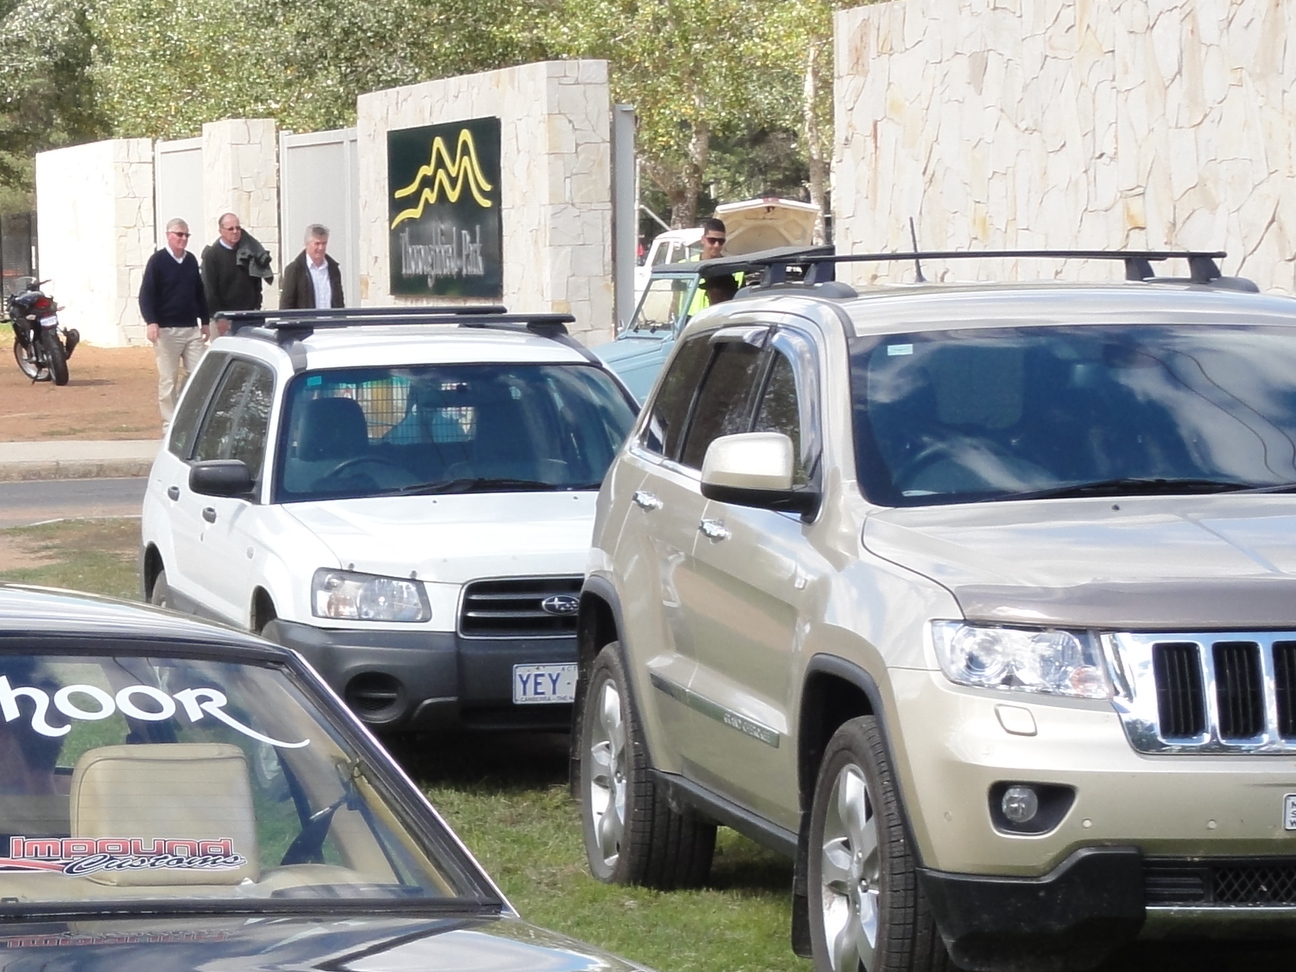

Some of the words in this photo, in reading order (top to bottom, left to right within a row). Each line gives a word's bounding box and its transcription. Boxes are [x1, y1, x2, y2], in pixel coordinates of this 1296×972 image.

[518, 673, 561, 696] YEY
[10, 836, 235, 861] Impound
[62, 853, 247, 878] Customs
